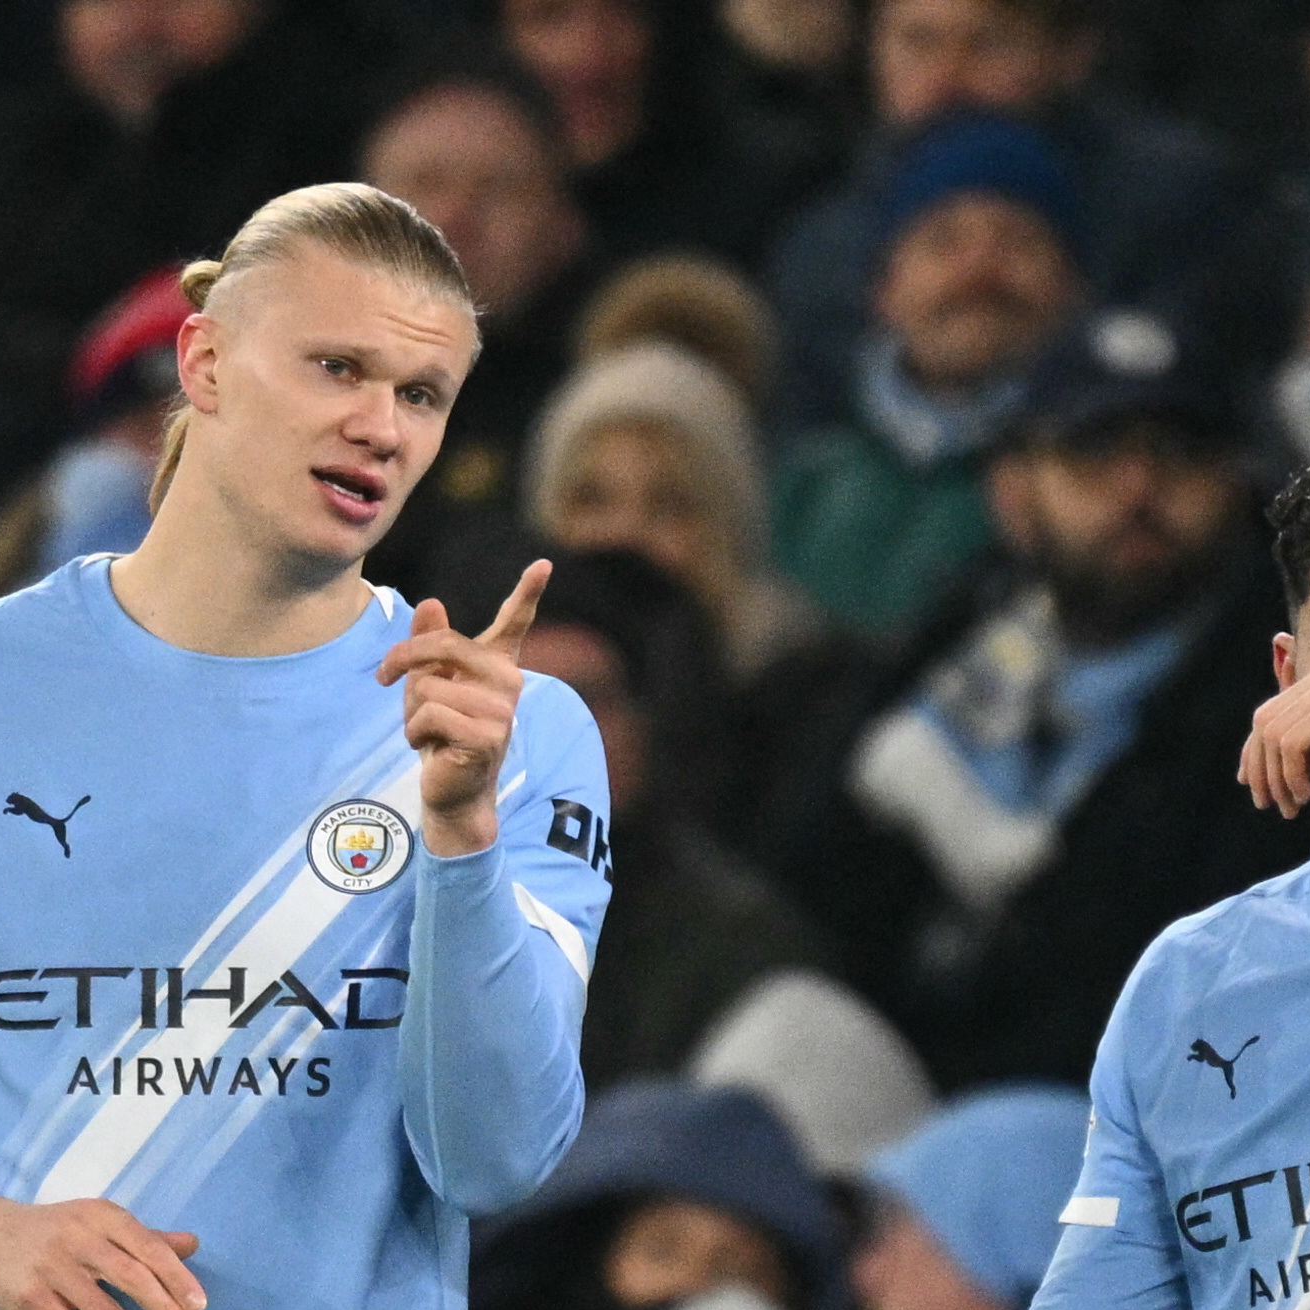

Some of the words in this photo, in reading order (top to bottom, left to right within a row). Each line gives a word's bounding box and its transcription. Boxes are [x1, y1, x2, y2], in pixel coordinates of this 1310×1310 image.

[320, 806, 403, 837] MANCHESTER
[343, 878, 373, 888] CITY
[66, 1056, 332, 1098] AIRWAYS
